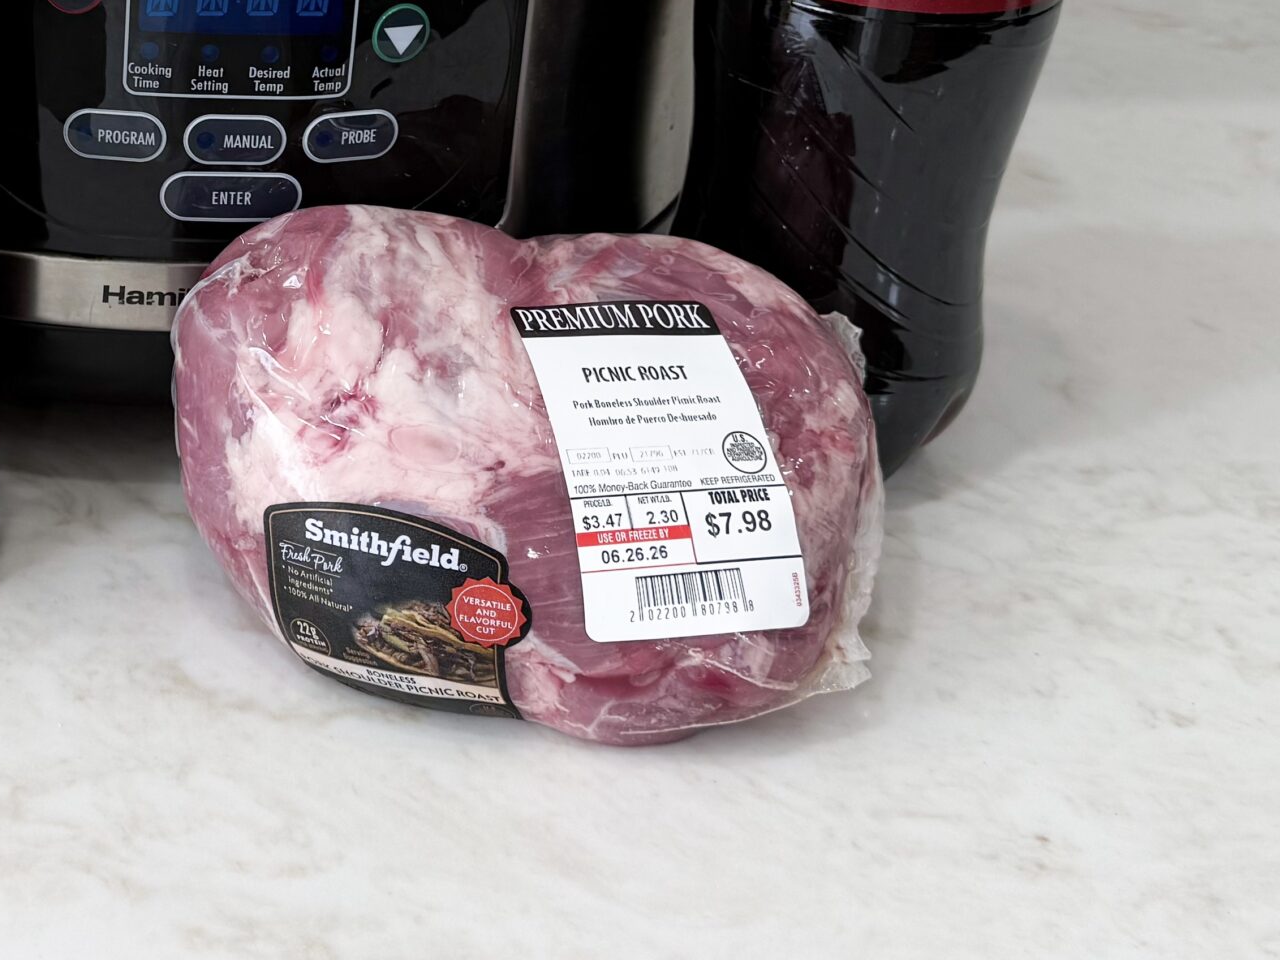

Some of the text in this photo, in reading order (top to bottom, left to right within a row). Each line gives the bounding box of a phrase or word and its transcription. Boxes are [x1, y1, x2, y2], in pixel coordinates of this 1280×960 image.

[128, 62, 172, 78] Cooking
[198, 66, 224, 78] Heat
[249, 66, 290, 79] Desired
[312, 64, 345, 78] Actual
[133, 76, 160, 89] Time
[191, 79, 229, 93] Setting
[254, 80, 284, 94] Temp
[313, 80, 342, 92] Temp
[98, 129, 155, 145] PROGRAM
[223, 134, 274, 149] MANUAL
[341, 129, 377, 145] PROBE
[212, 192, 252, 205] ENTER
[515, 304, 711, 331] PREMIUM PORK
[582, 365, 688, 383] PICNIC ROAST
[573, 399, 594, 410] Pork
[594, 398, 633, 409] Boneless
[633, 397, 670, 408] Shoulder
[697, 394, 721, 404] Roast
[626, 415, 636, 425] de
[636, 414, 666, 424] Puerco
[573, 484, 597, 495] 100%
[598, 481, 649, 494] Money-Back
[700, 473, 776, 487] KEEP REFRIGERATED
[637, 496, 649, 505] NET
[708, 488, 771, 505] TOTAL PRICE
[582, 513, 623, 531] $3.47
[646, 509, 679, 525] 2.30
[705, 509, 773, 538] $7.98
[304, 517, 460, 572] Smithfield
[597, 529, 669, 544] USE OR FREEZE BY
[279, 542, 343, 573] Fresh Pork
[601, 545, 668, 565] 06.26.26
[287, 565, 333, 587] No Artificial
[288, 586, 308, 600] 100%
[308, 593, 320, 603] All
[463, 595, 511, 611] VERSATILE
[629, 599, 755, 623] 2 02200 80798 8
[476, 608, 497, 618] AND
[459, 614, 513, 629] FLAVORFUL
[296, 620, 320, 640] 22g
[476, 626, 496, 635] CUT
[366, 669, 417, 684] BONELESS
[405, 685, 455, 697] PICNIC
[456, 689, 500, 702] ROAST
